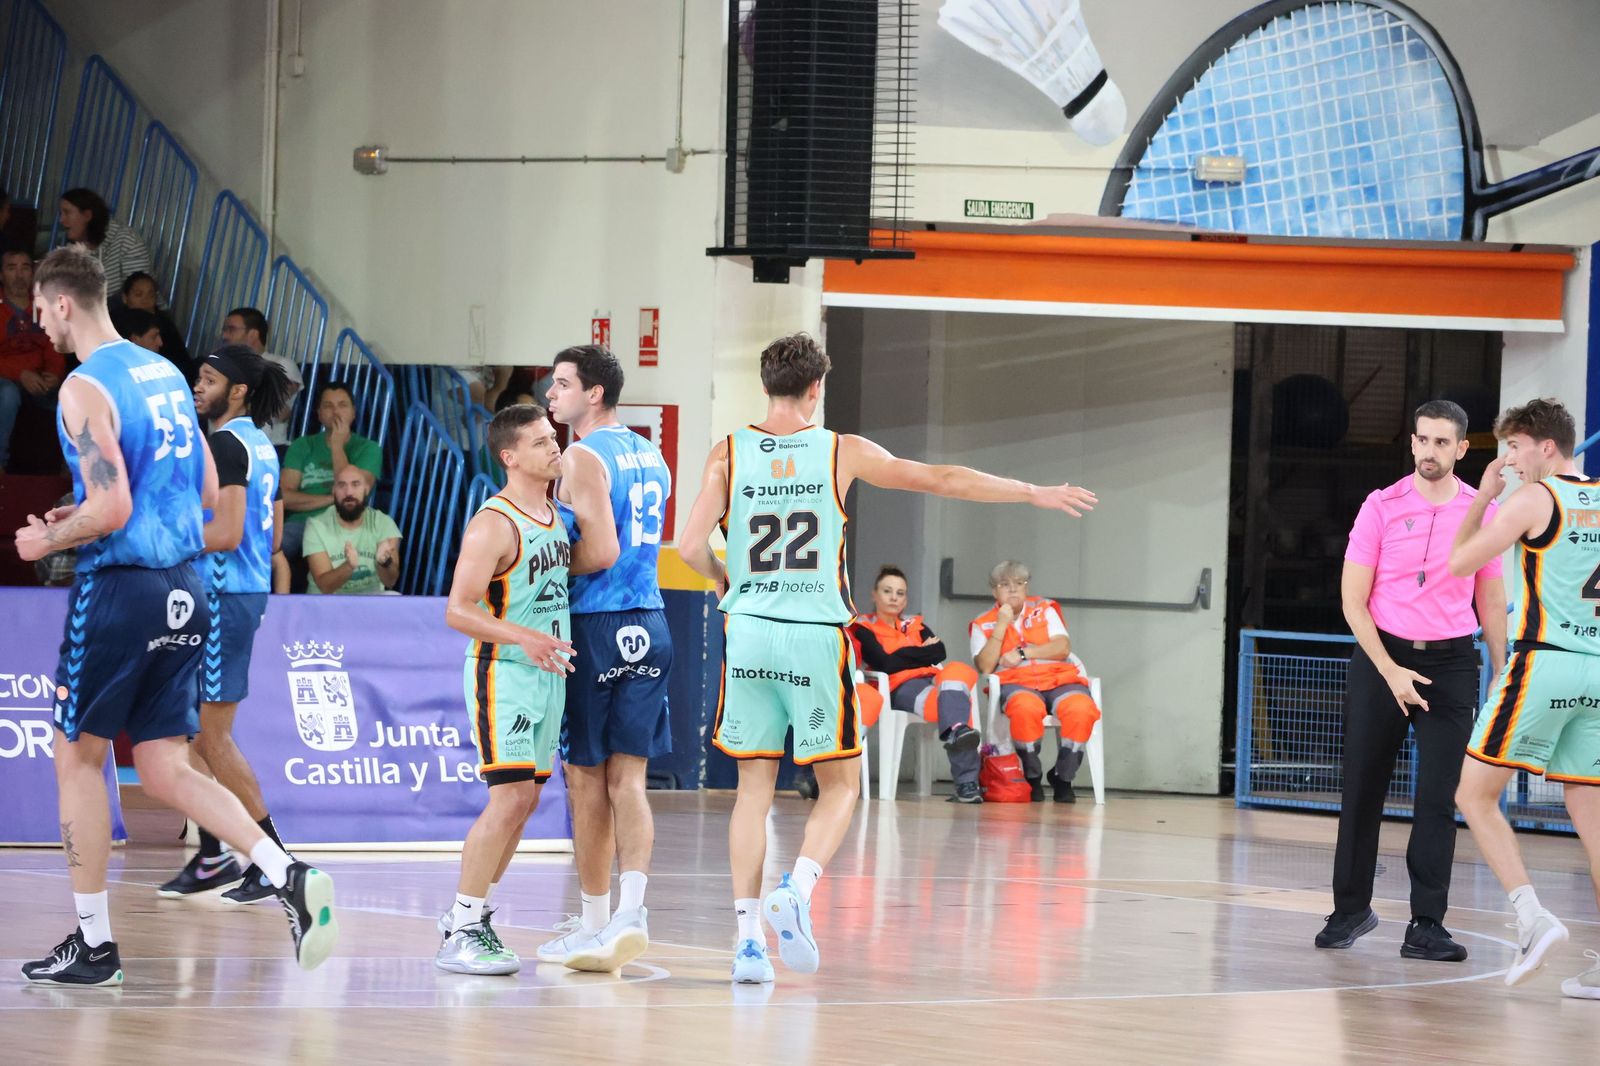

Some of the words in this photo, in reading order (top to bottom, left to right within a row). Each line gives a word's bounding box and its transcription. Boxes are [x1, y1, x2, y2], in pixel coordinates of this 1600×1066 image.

[967, 200, 989, 216] SALIDA
[991, 201, 1031, 218] EMERGENCIA
[145, 389, 194, 461] 55
[262, 472, 274, 530] 3
[628, 480, 663, 547] 13
[748, 510, 819, 574] 22
[781, 580, 825, 593] hotels
[731, 667, 811, 687] motorisa
[369, 721, 460, 748] Junta
[800, 734, 832, 748] ALUA
[284, 756, 400, 785] Castilla
[409, 761, 429, 792] y
